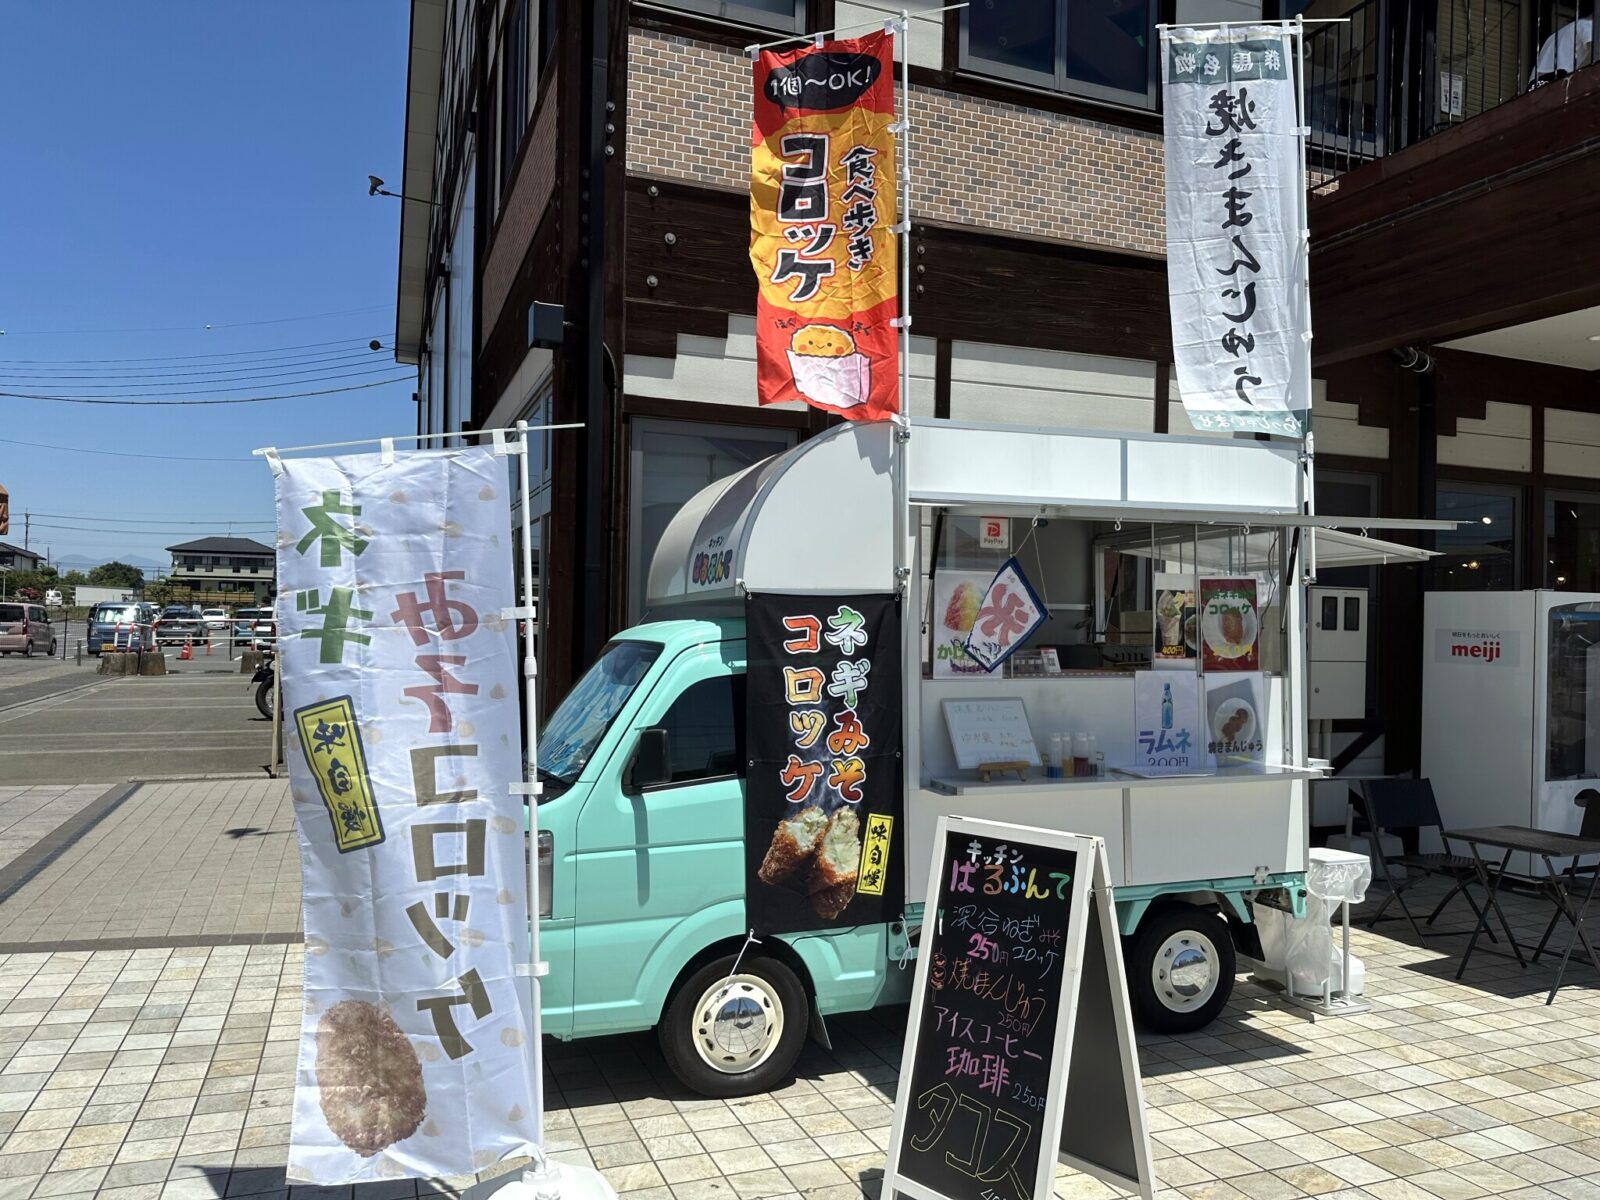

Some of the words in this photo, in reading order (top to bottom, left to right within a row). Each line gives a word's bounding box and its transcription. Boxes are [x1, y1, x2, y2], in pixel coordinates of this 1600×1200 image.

[771, 132, 836, 303] コロッケ
[841, 145, 879, 271] 食べ歩き
[978, 583, 1029, 647] 氷
[1451, 641, 1500, 662] meiji
[780, 615, 826, 802] コロッケ
[825, 605, 871, 802] ネギみそ
[1138, 728, 1192, 754] ラムネ
[1148, 757, 1189, 767] 200円
[1208, 740, 1263, 754] 焼きまんじゅう
[863, 821, 888, 888] 味自慢
[966, 840, 1024, 865] キッチン
[967, 932, 1009, 966] 250円
[934, 1006, 1043, 1059] アイスコーヒー
[998, 1011, 1030, 1036] 250円
[945, 1046, 1010, 1096] 珈琲
[910, 1081, 1032, 1200] タコス
